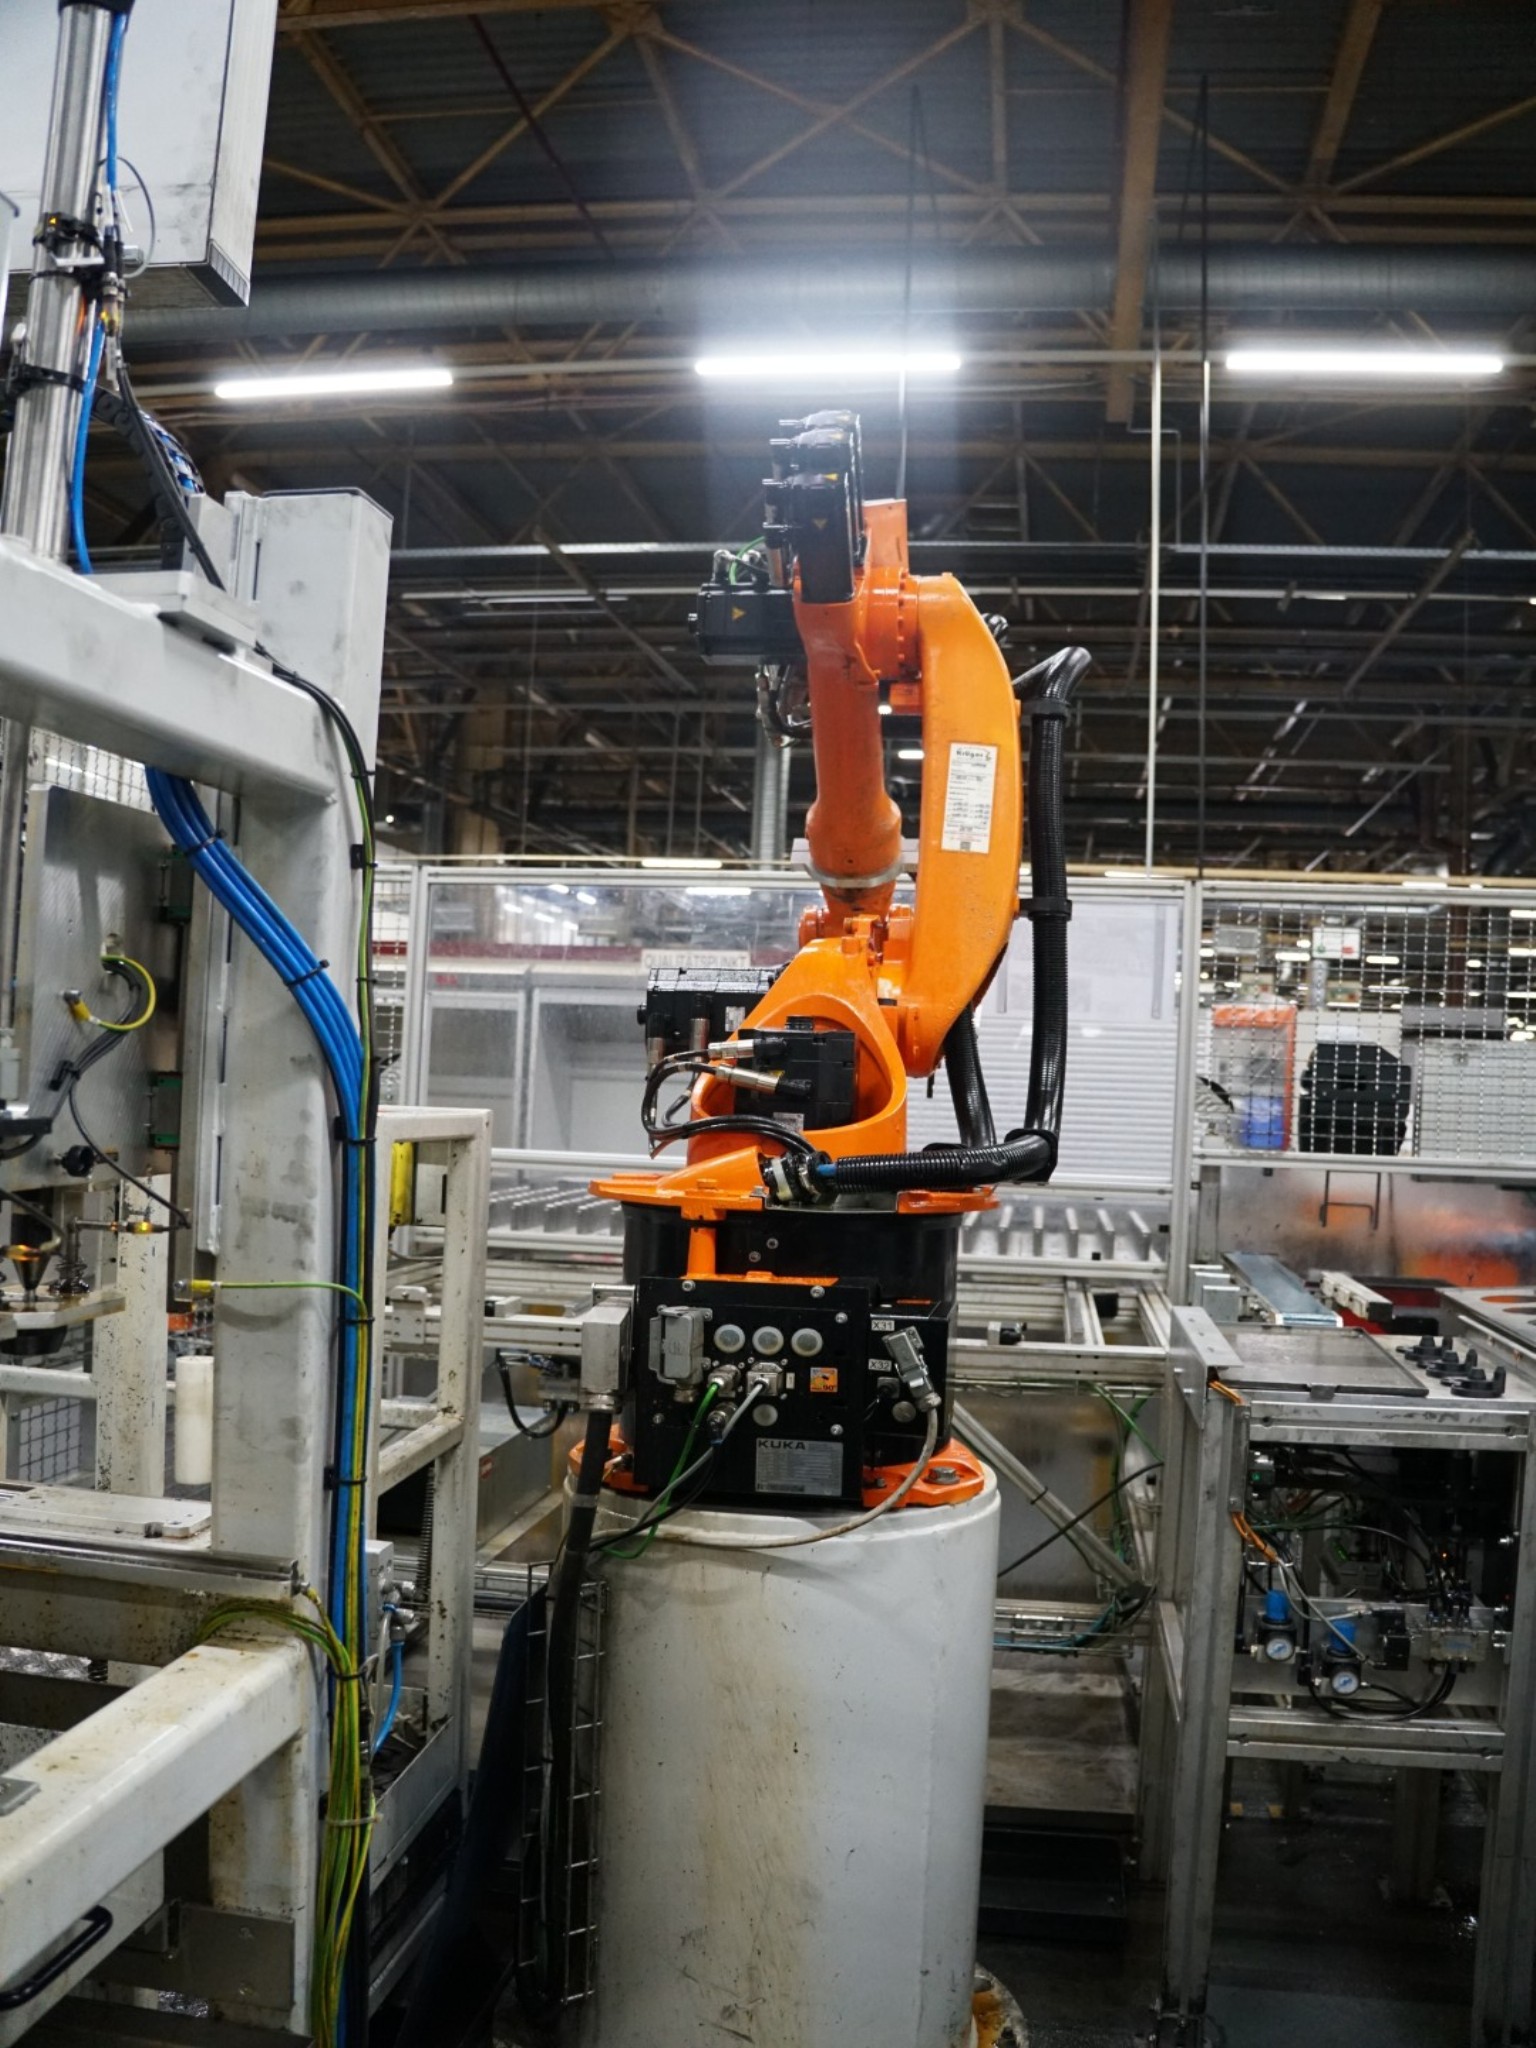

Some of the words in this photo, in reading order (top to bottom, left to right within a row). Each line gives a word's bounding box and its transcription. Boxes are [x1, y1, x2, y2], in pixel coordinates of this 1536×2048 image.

[872, 1321, 893, 1330] X31
[870, 1360, 890, 1370] X32
[758, 1440, 806, 1450] KUKA
